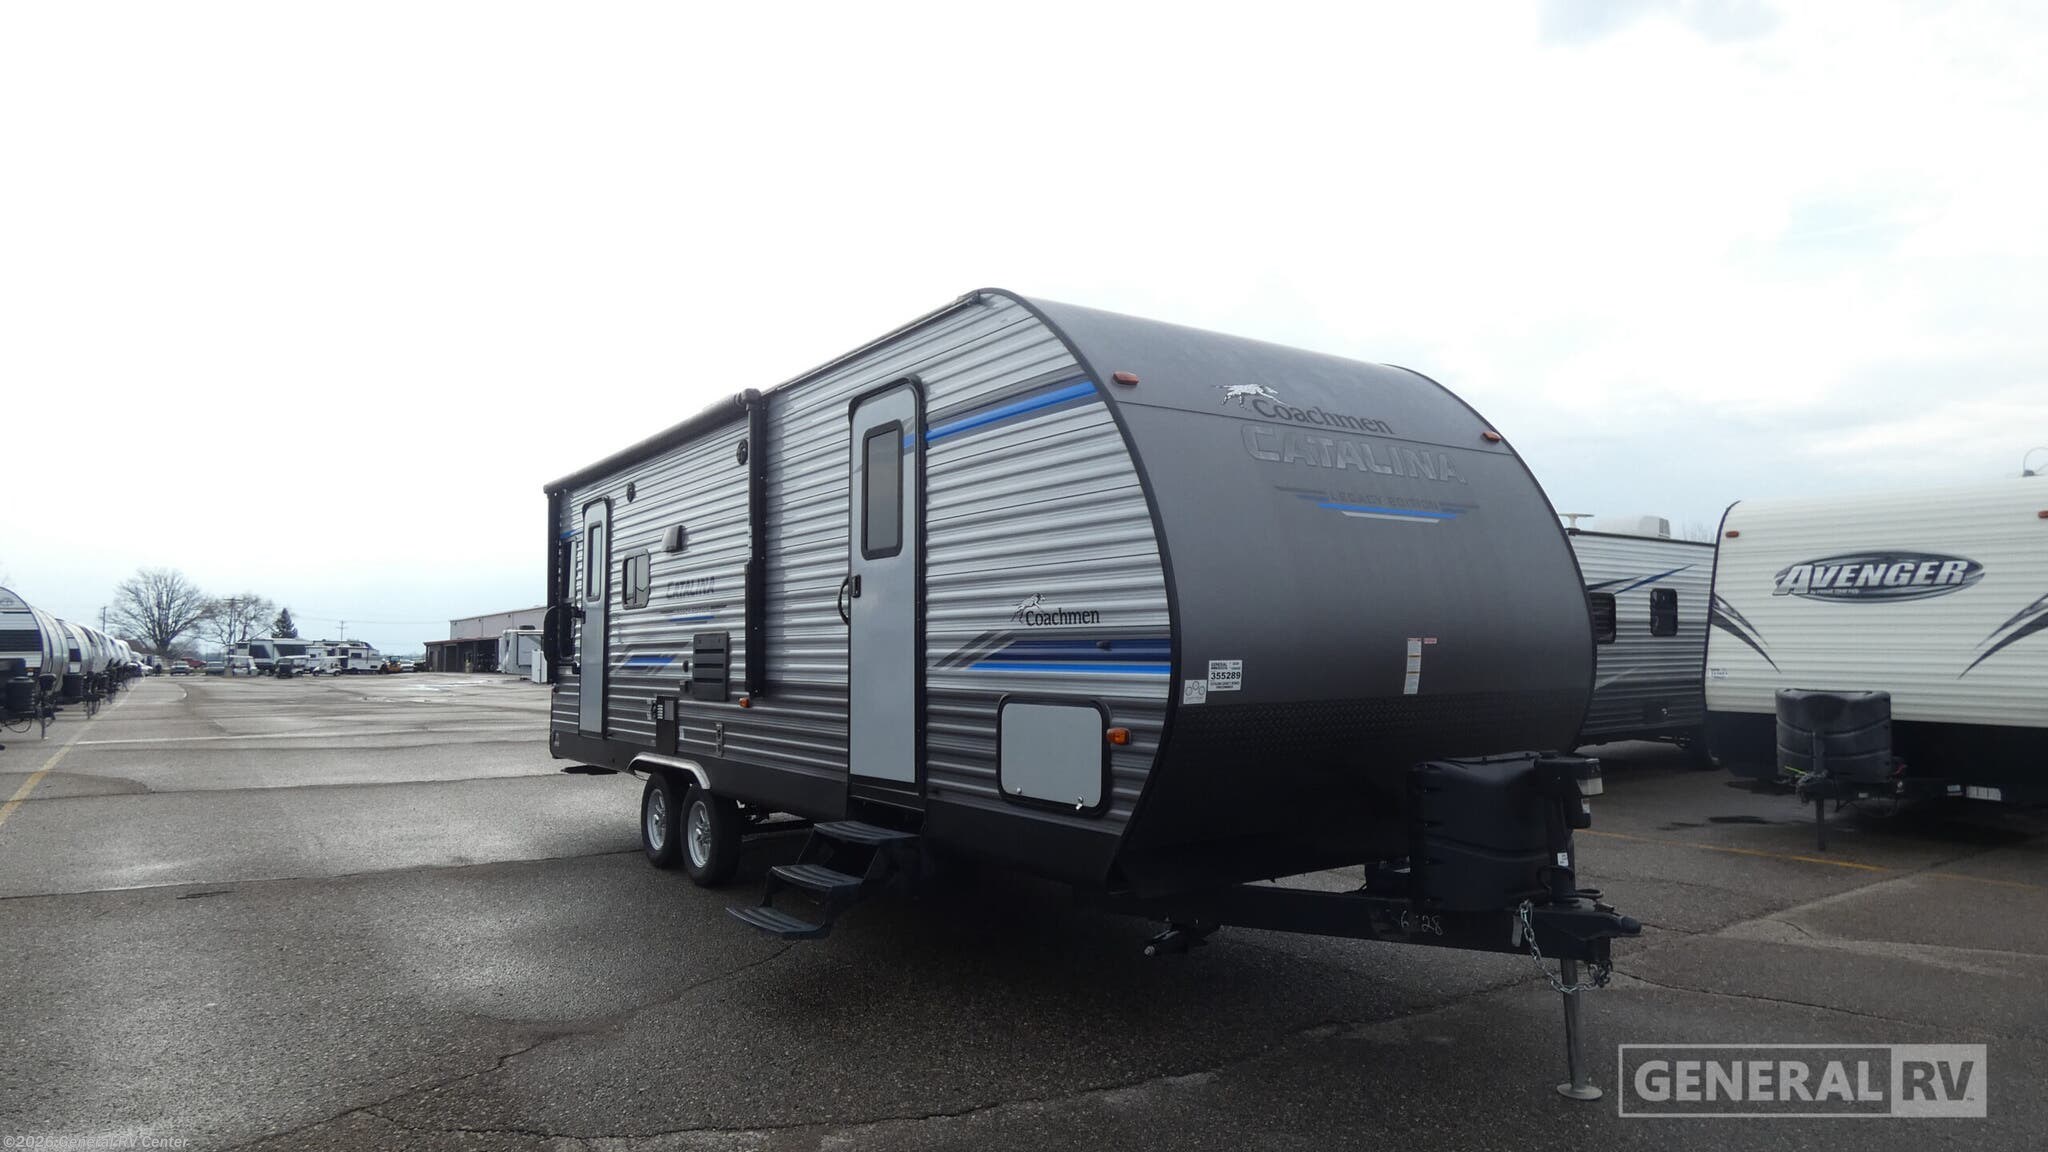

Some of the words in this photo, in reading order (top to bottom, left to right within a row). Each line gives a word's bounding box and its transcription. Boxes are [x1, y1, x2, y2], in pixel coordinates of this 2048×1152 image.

[1252, 399, 1394, 434] Coachmen
[1241, 424, 1468, 484] CATALINA
[666, 576, 715, 599] CATALINA
[1772, 559, 1969, 596] AVENGER
[1026, 607, 1100, 626] Coachmen
[1210, 671, 1241, 680] 355289
